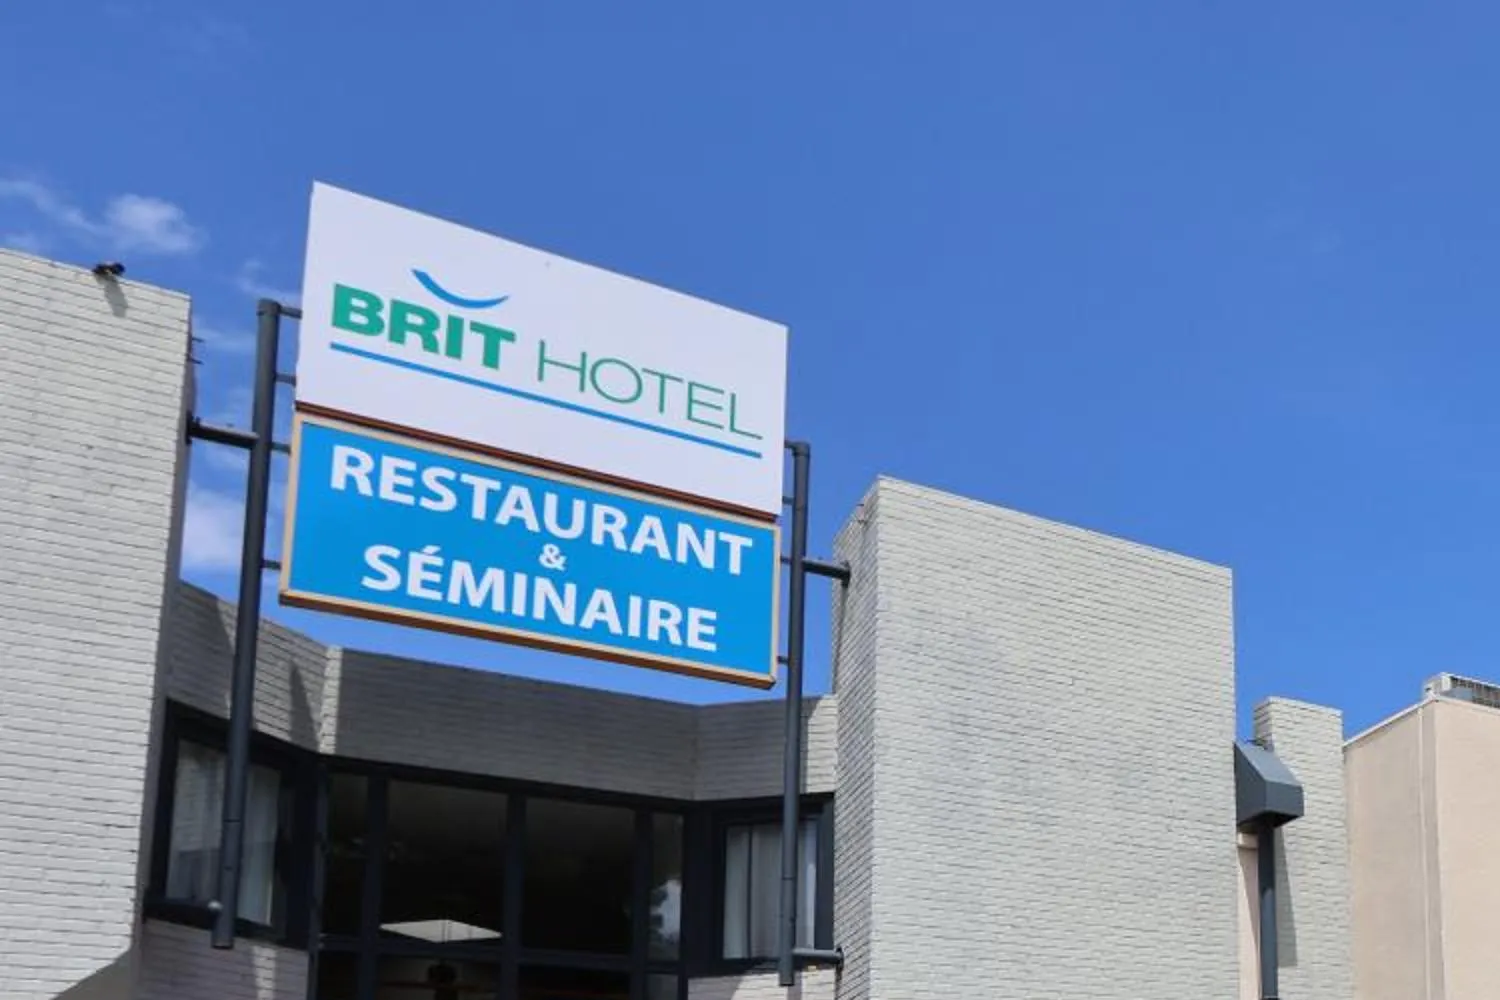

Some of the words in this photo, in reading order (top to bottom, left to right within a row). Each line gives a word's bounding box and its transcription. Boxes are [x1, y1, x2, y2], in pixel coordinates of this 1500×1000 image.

[330, 282, 517, 370] BRIT
[537, 338, 764, 441] HOTEL
[330, 444, 753, 576] RESTAURANT
[538, 543, 568, 571] &
[361, 543, 718, 652] SÉMINAIRE
